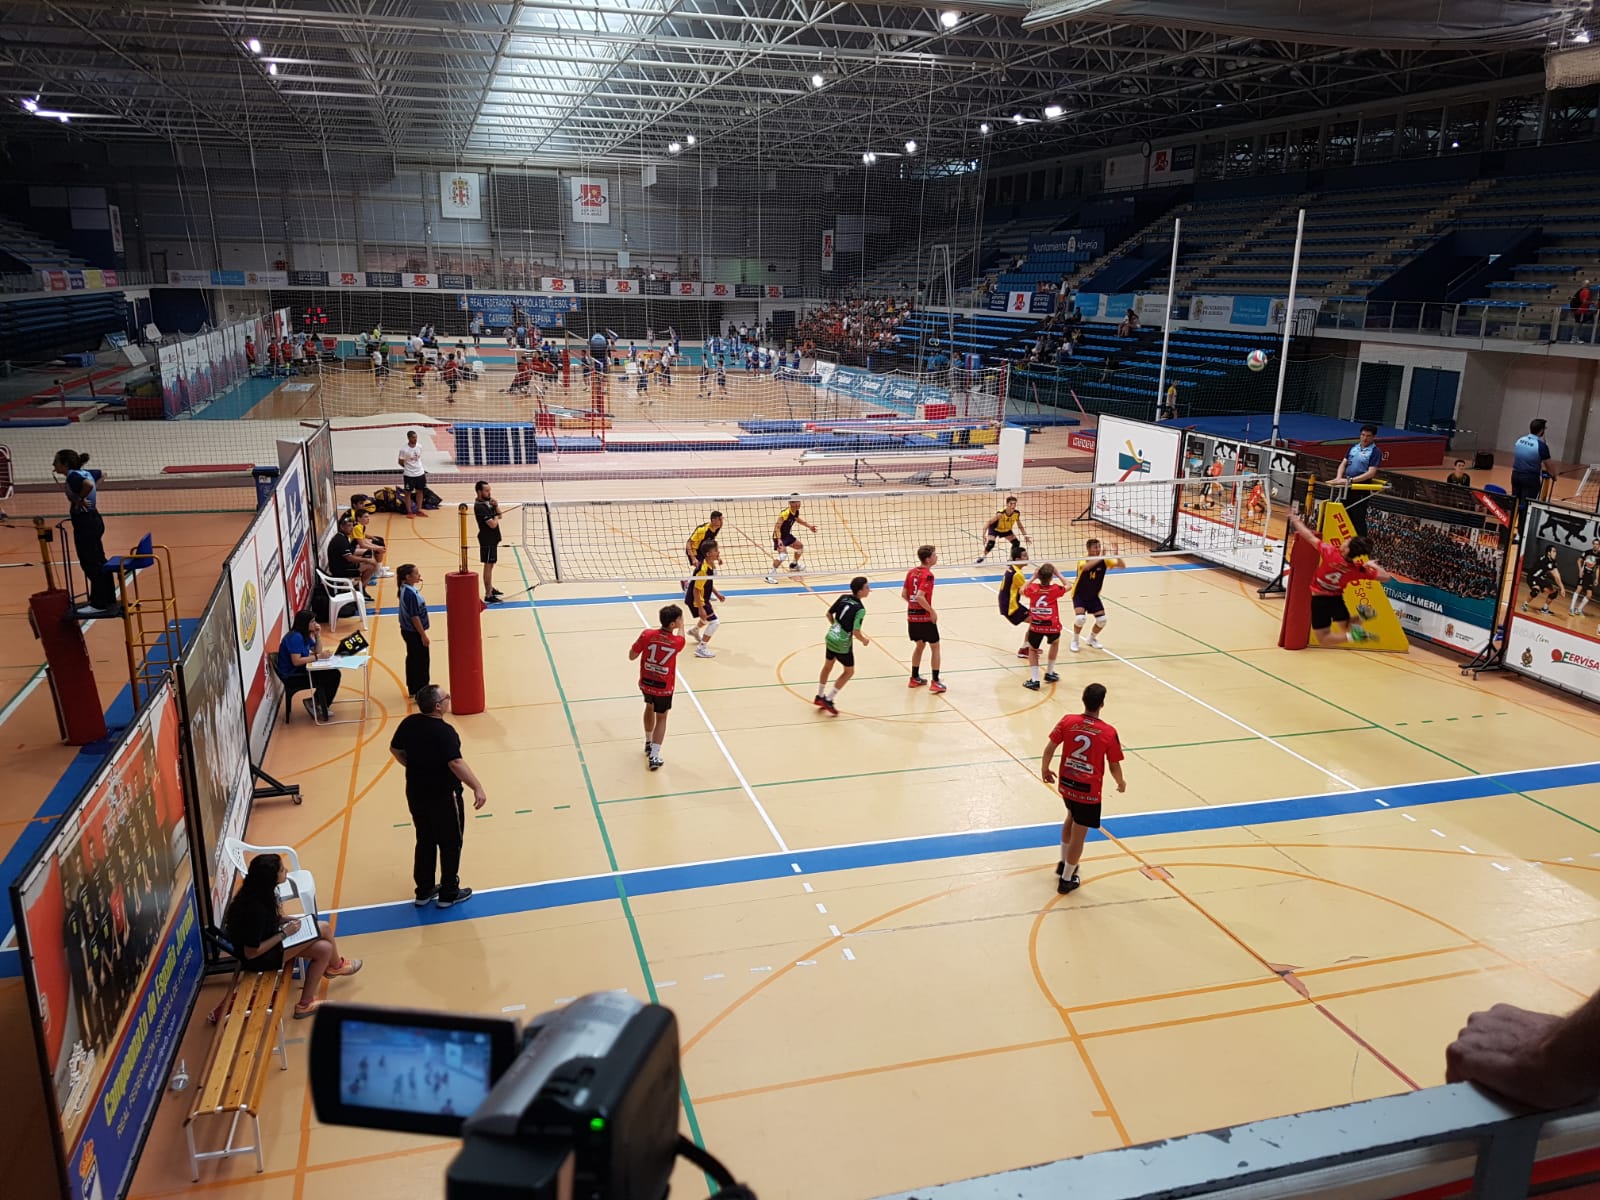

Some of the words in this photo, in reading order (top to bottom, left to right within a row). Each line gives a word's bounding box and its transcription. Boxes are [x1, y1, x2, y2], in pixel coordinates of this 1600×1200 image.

[1035, 595, 1049, 608] 6
[646, 643, 677, 666] 17
[1071, 734, 1092, 762] 2
